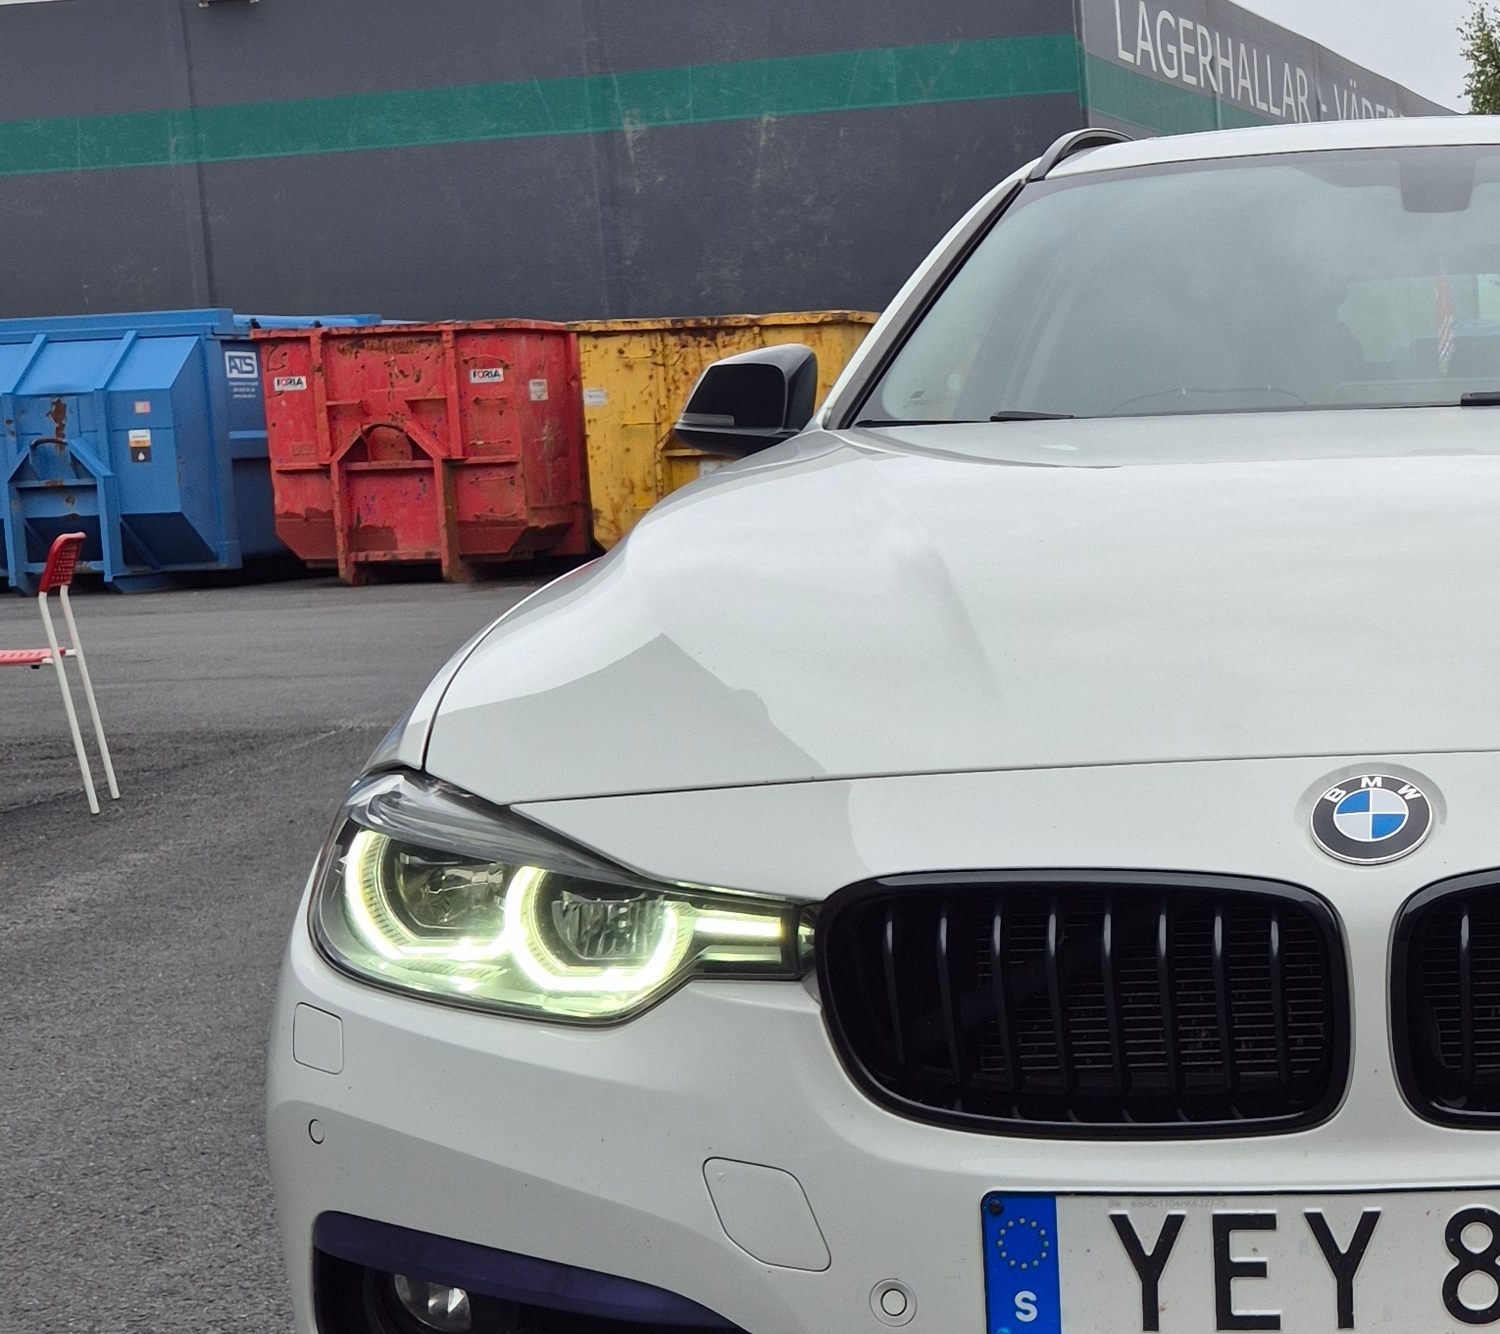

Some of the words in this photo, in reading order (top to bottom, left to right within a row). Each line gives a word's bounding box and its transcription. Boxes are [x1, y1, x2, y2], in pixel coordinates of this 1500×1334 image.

[1322, 776, 1422, 803] BMW
[1107, 1209, 1383, 1333] YEY
[1013, 1290, 1039, 1323] S
